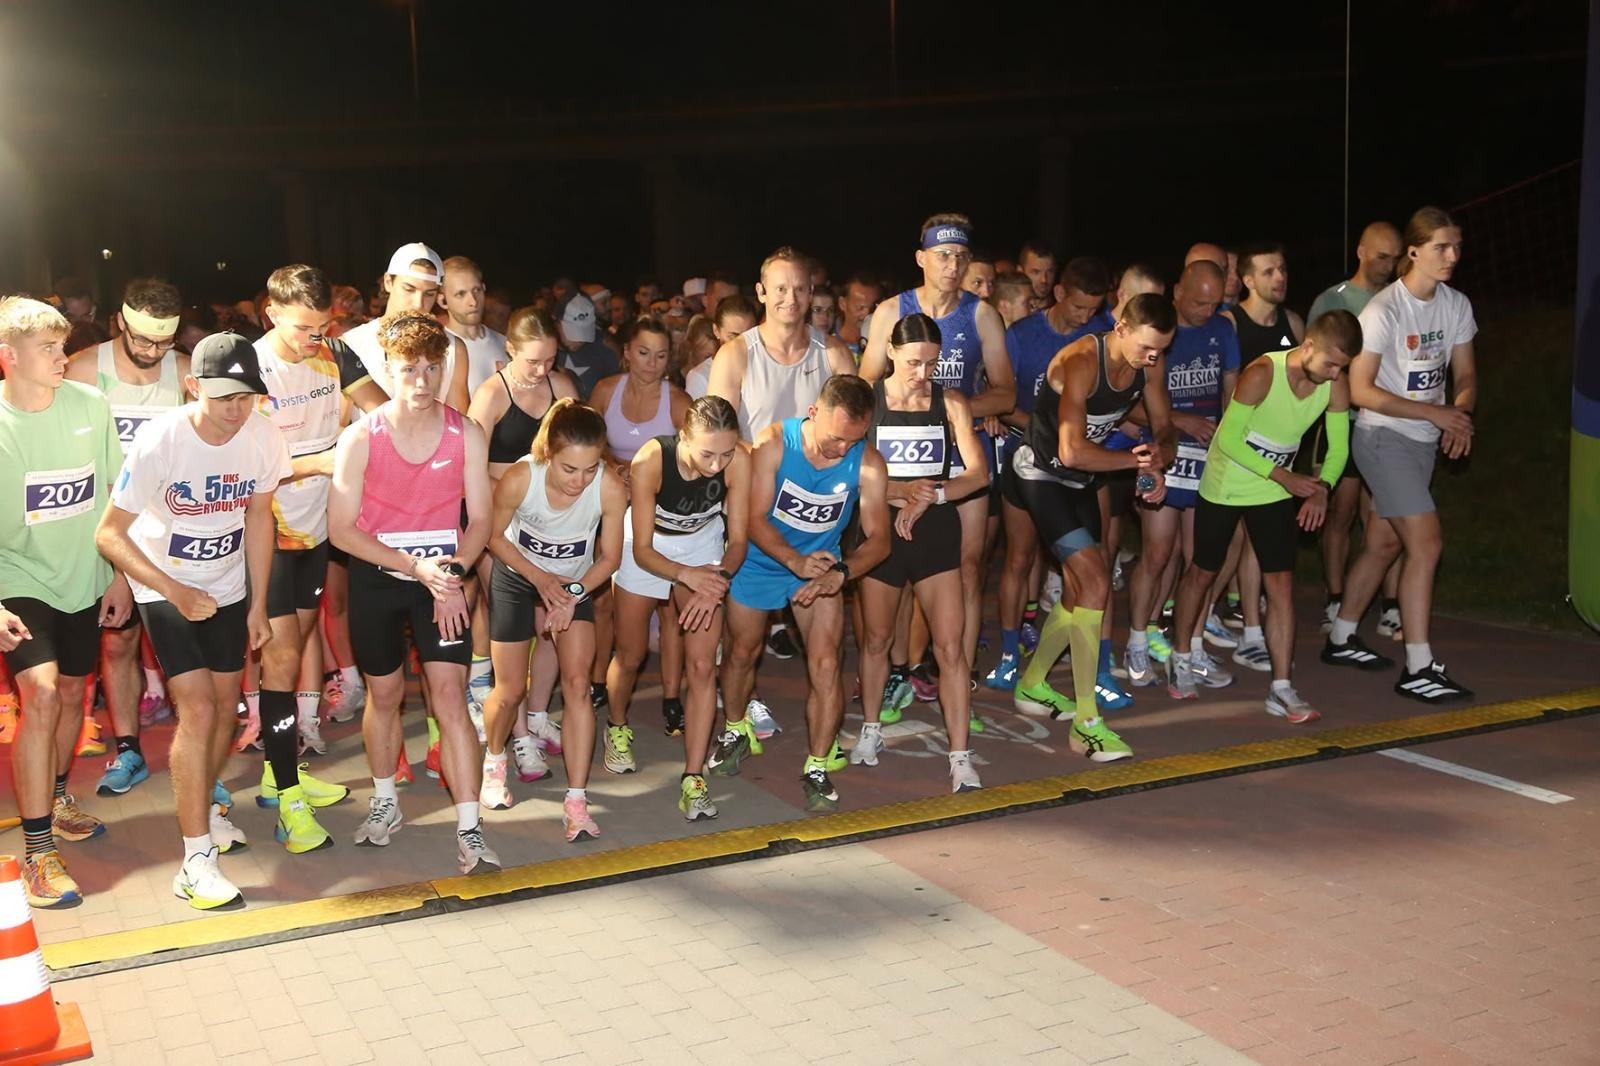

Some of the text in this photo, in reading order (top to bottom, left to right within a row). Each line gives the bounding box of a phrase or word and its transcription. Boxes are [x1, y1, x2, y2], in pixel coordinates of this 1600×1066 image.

[1420, 330, 1444, 343] BEG
[309, 383, 336, 399] GROUP
[889, 440, 934, 462] 262
[205, 475, 221, 502] 5
[223, 473, 239, 483] UKS
[38, 479, 89, 508] 207
[787, 498, 834, 522] 243
[182, 534, 234, 559] 458
[529, 538, 575, 558] 342
